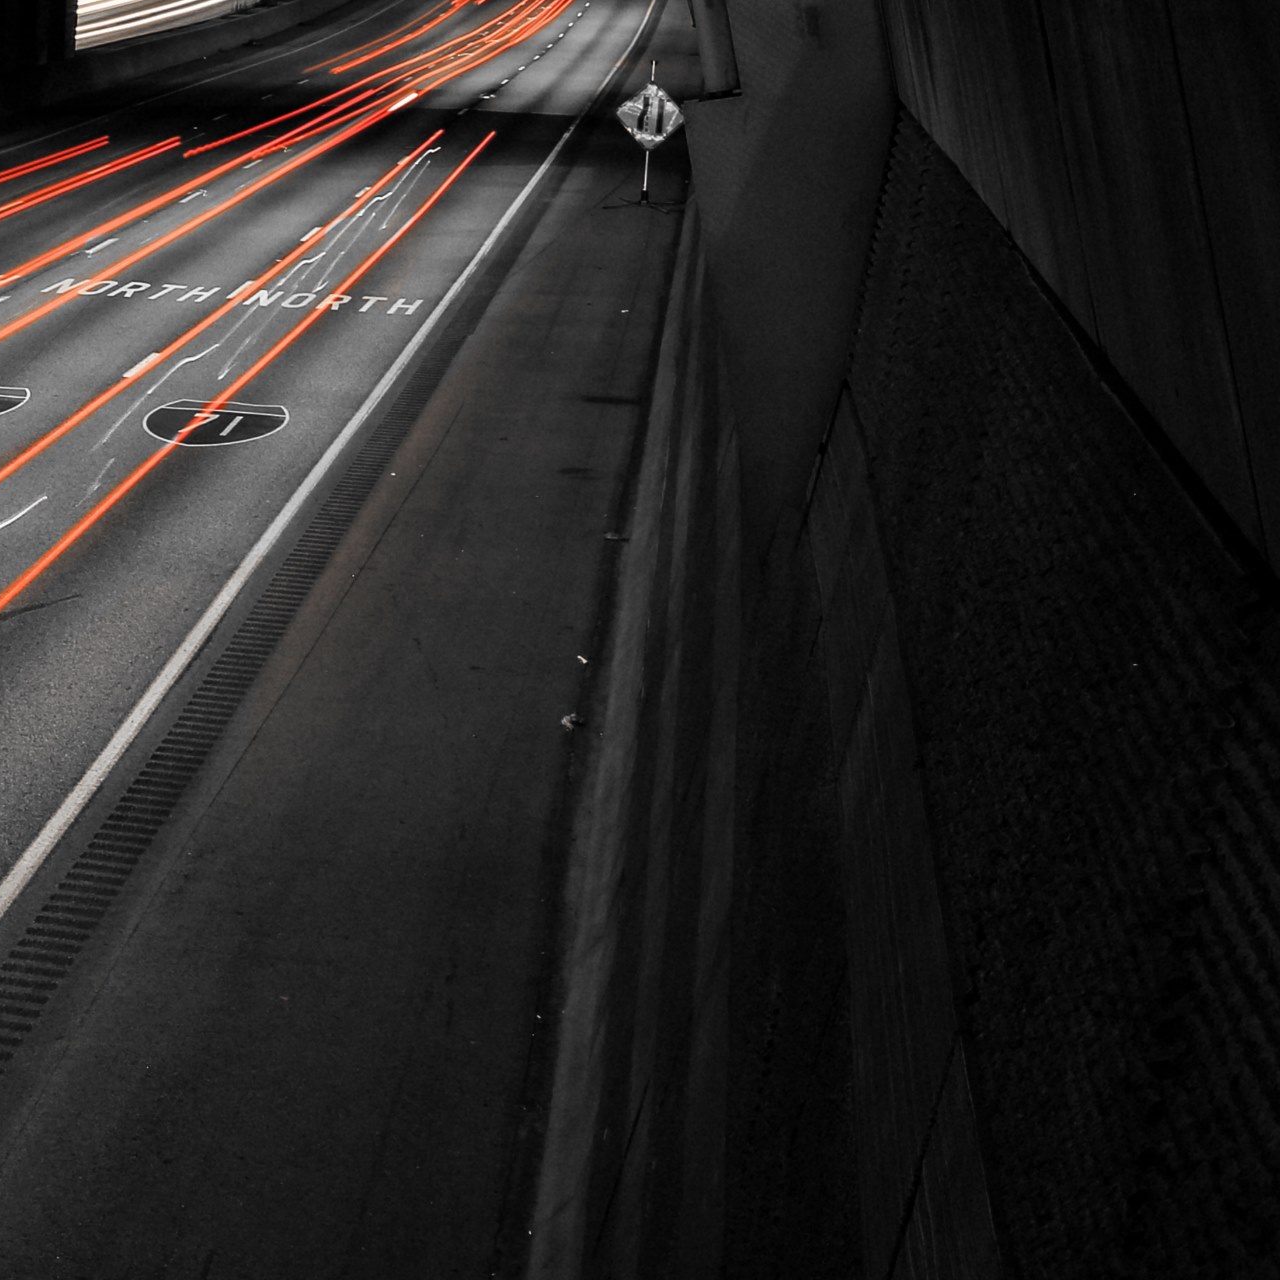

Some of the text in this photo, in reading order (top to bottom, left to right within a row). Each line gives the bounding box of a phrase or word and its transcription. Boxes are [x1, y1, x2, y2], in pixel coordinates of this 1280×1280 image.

[40, 277, 221, 303] NORTH
[242, 288, 424, 315] NORTH
[177, 413, 245, 437] 71
